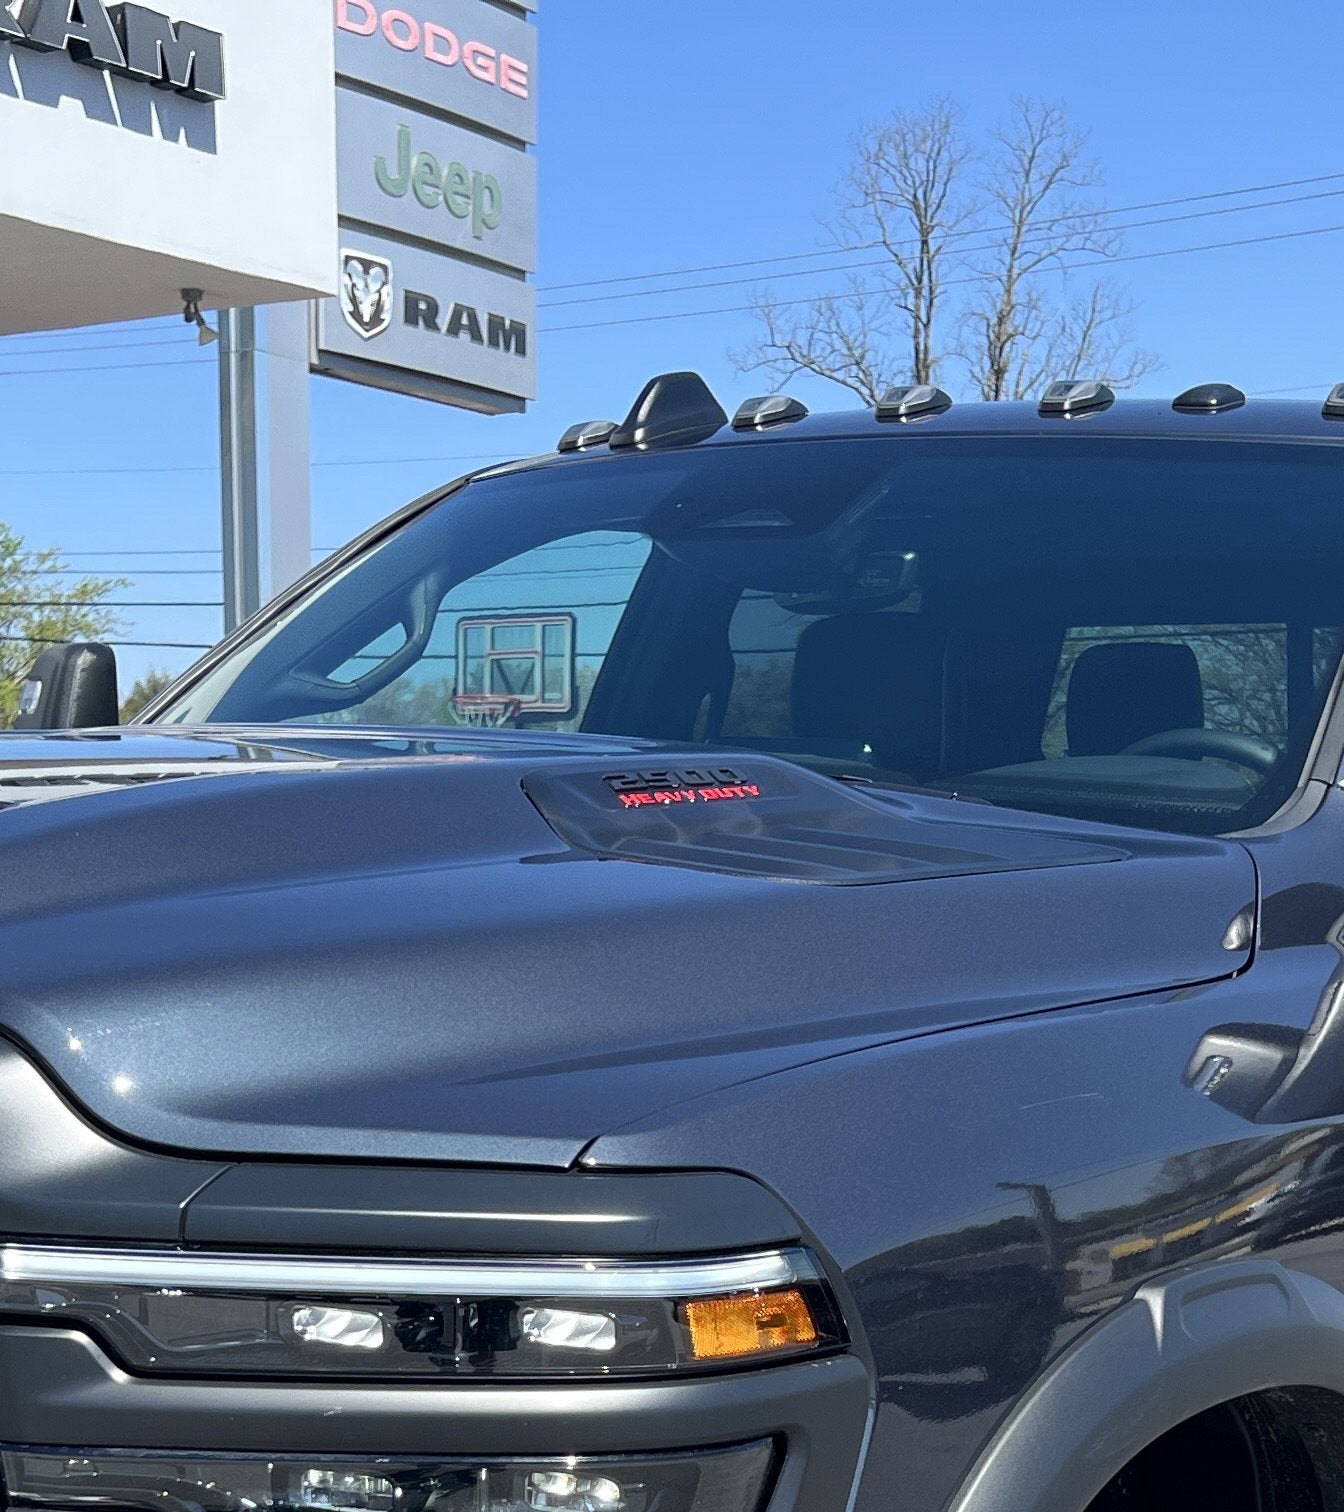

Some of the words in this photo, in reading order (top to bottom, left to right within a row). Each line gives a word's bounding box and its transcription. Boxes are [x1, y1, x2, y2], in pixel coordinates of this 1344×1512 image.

[336, 0, 529, 99] DODGE
[373, 124, 502, 240] Jeep
[403, 288, 527, 359] RAM
[603, 768, 748, 792] 2500
[619, 788, 695, 808] HEAVY
[697, 785, 760, 802] DUTY
